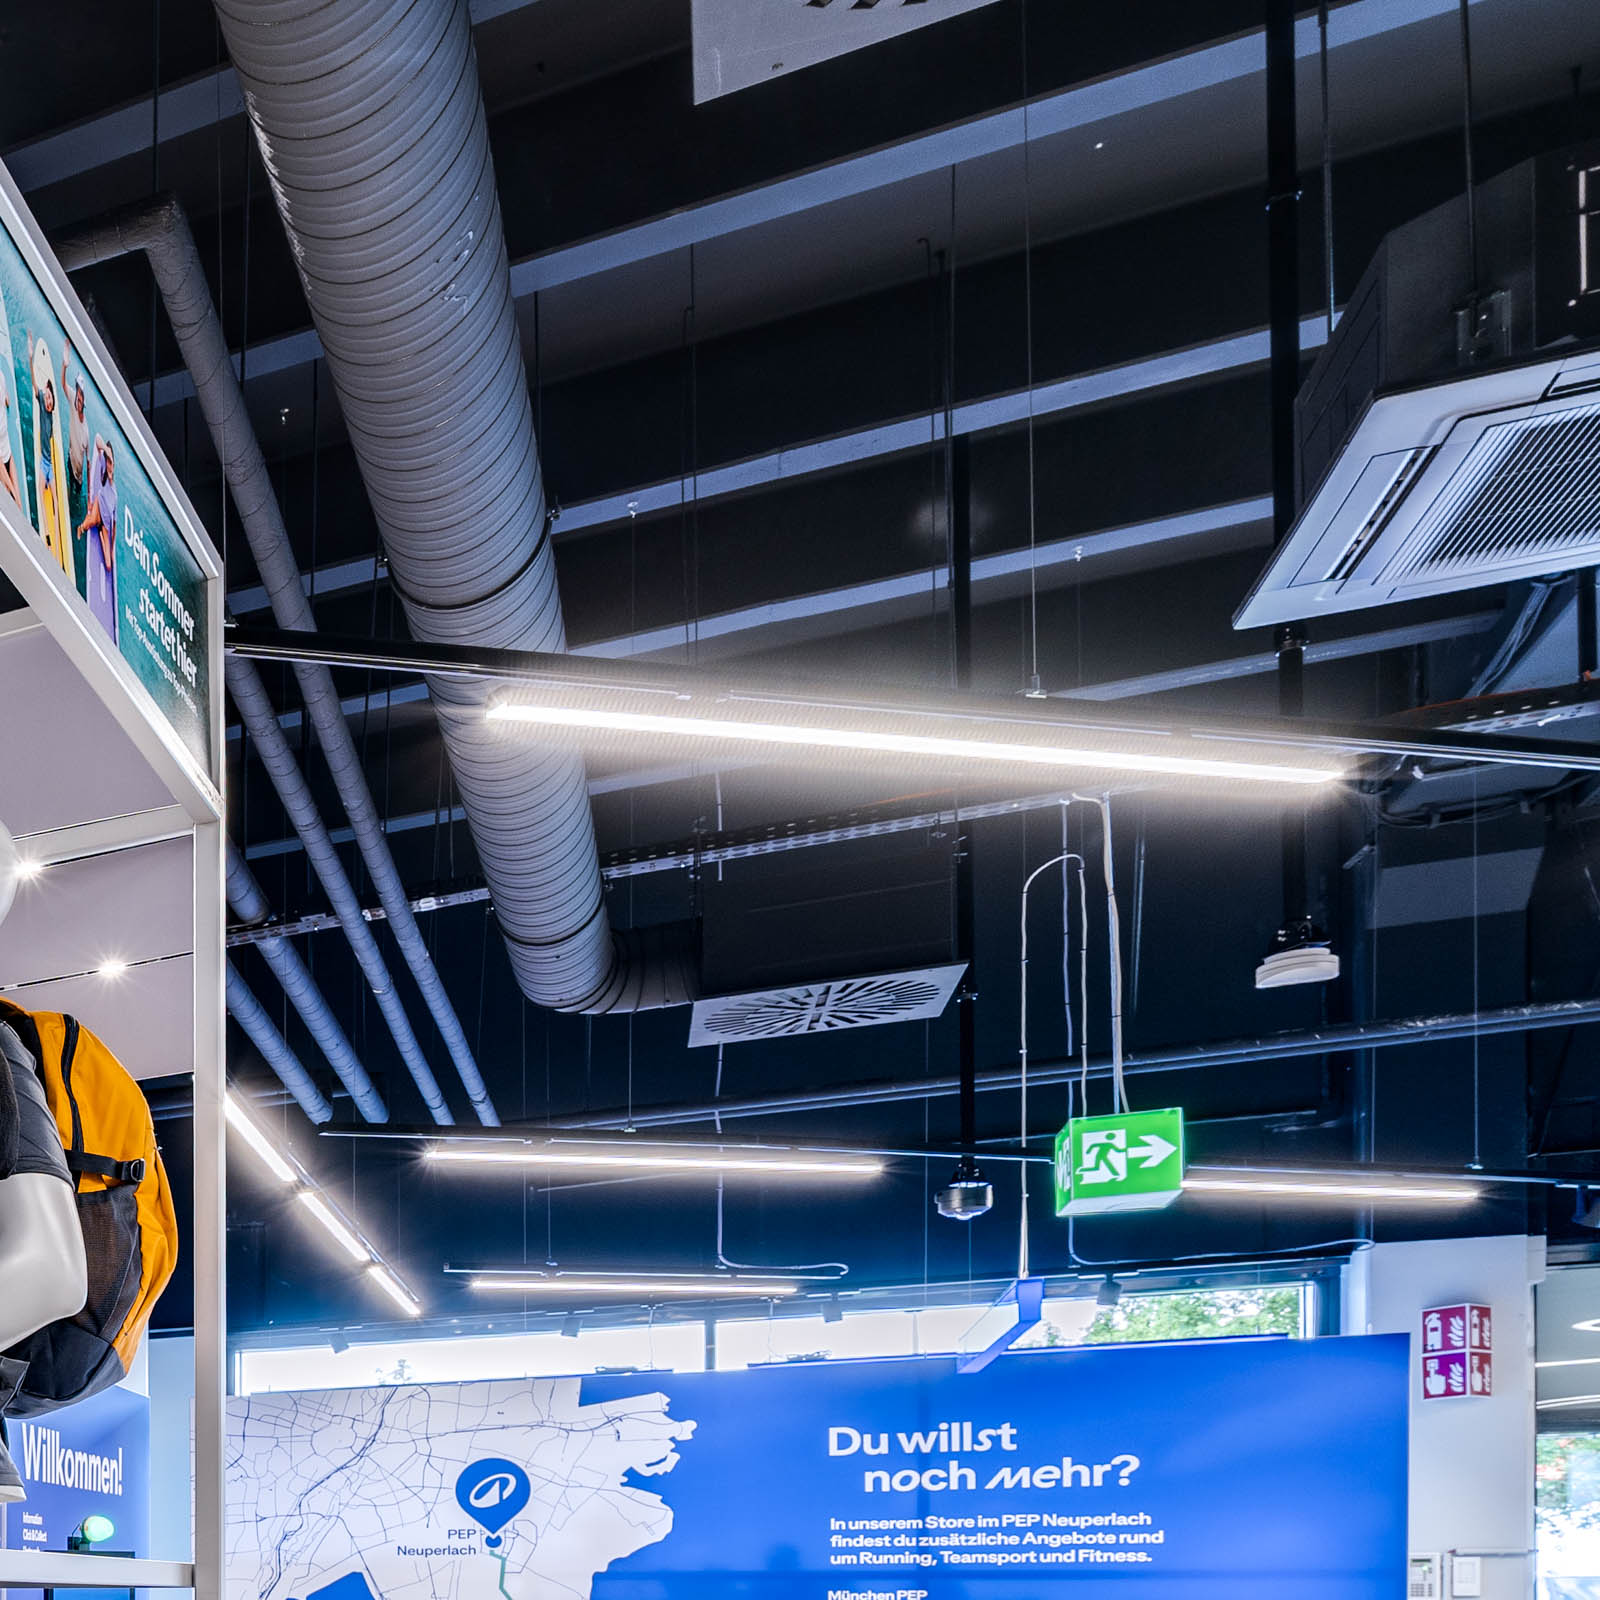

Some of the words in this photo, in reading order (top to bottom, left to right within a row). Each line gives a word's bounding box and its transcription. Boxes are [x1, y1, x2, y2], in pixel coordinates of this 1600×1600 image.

[124, 504, 150, 577] Dein
[150, 552, 194, 641] Sommer
[139, 588, 176, 662] startet
[176, 632, 197, 689] hier
[828, 1426, 888, 1456] Du
[897, 1421, 1017, 1454] willst
[22, 1422, 123, 1496] Willkommen!
[865, 1460, 976, 1492] noch
[985, 1454, 1140, 1489] mehr?
[830, 1518, 846, 1531] In
[848, 1517, 923, 1530] unserem
[925, 1515, 975, 1529] Store
[977, 1515, 999, 1528] im
[1001, 1514, 1041, 1527] PEP
[1042, 1512, 1152, 1529] Neuperlach
[447, 1528, 477, 1539] PEP
[830, 1534, 892, 1548] findest
[894, 1533, 917, 1547] du
[918, 1532, 1020, 1547] zusätzliche
[1022, 1531, 1117, 1548] Angebote
[1118, 1530, 1164, 1545] rund
[397, 1545, 477, 1557] Neuperlach
[830, 1554, 857, 1565] um
[859, 1551, 938, 1567] Running,
[940, 1550, 1037, 1566] Teamsport
[1039, 1550, 1076, 1563] und
[1078, 1549, 1153, 1564] Fitness.
[827, 1589, 895, 1600] München
[897, 1590, 928, 1600] PEP
